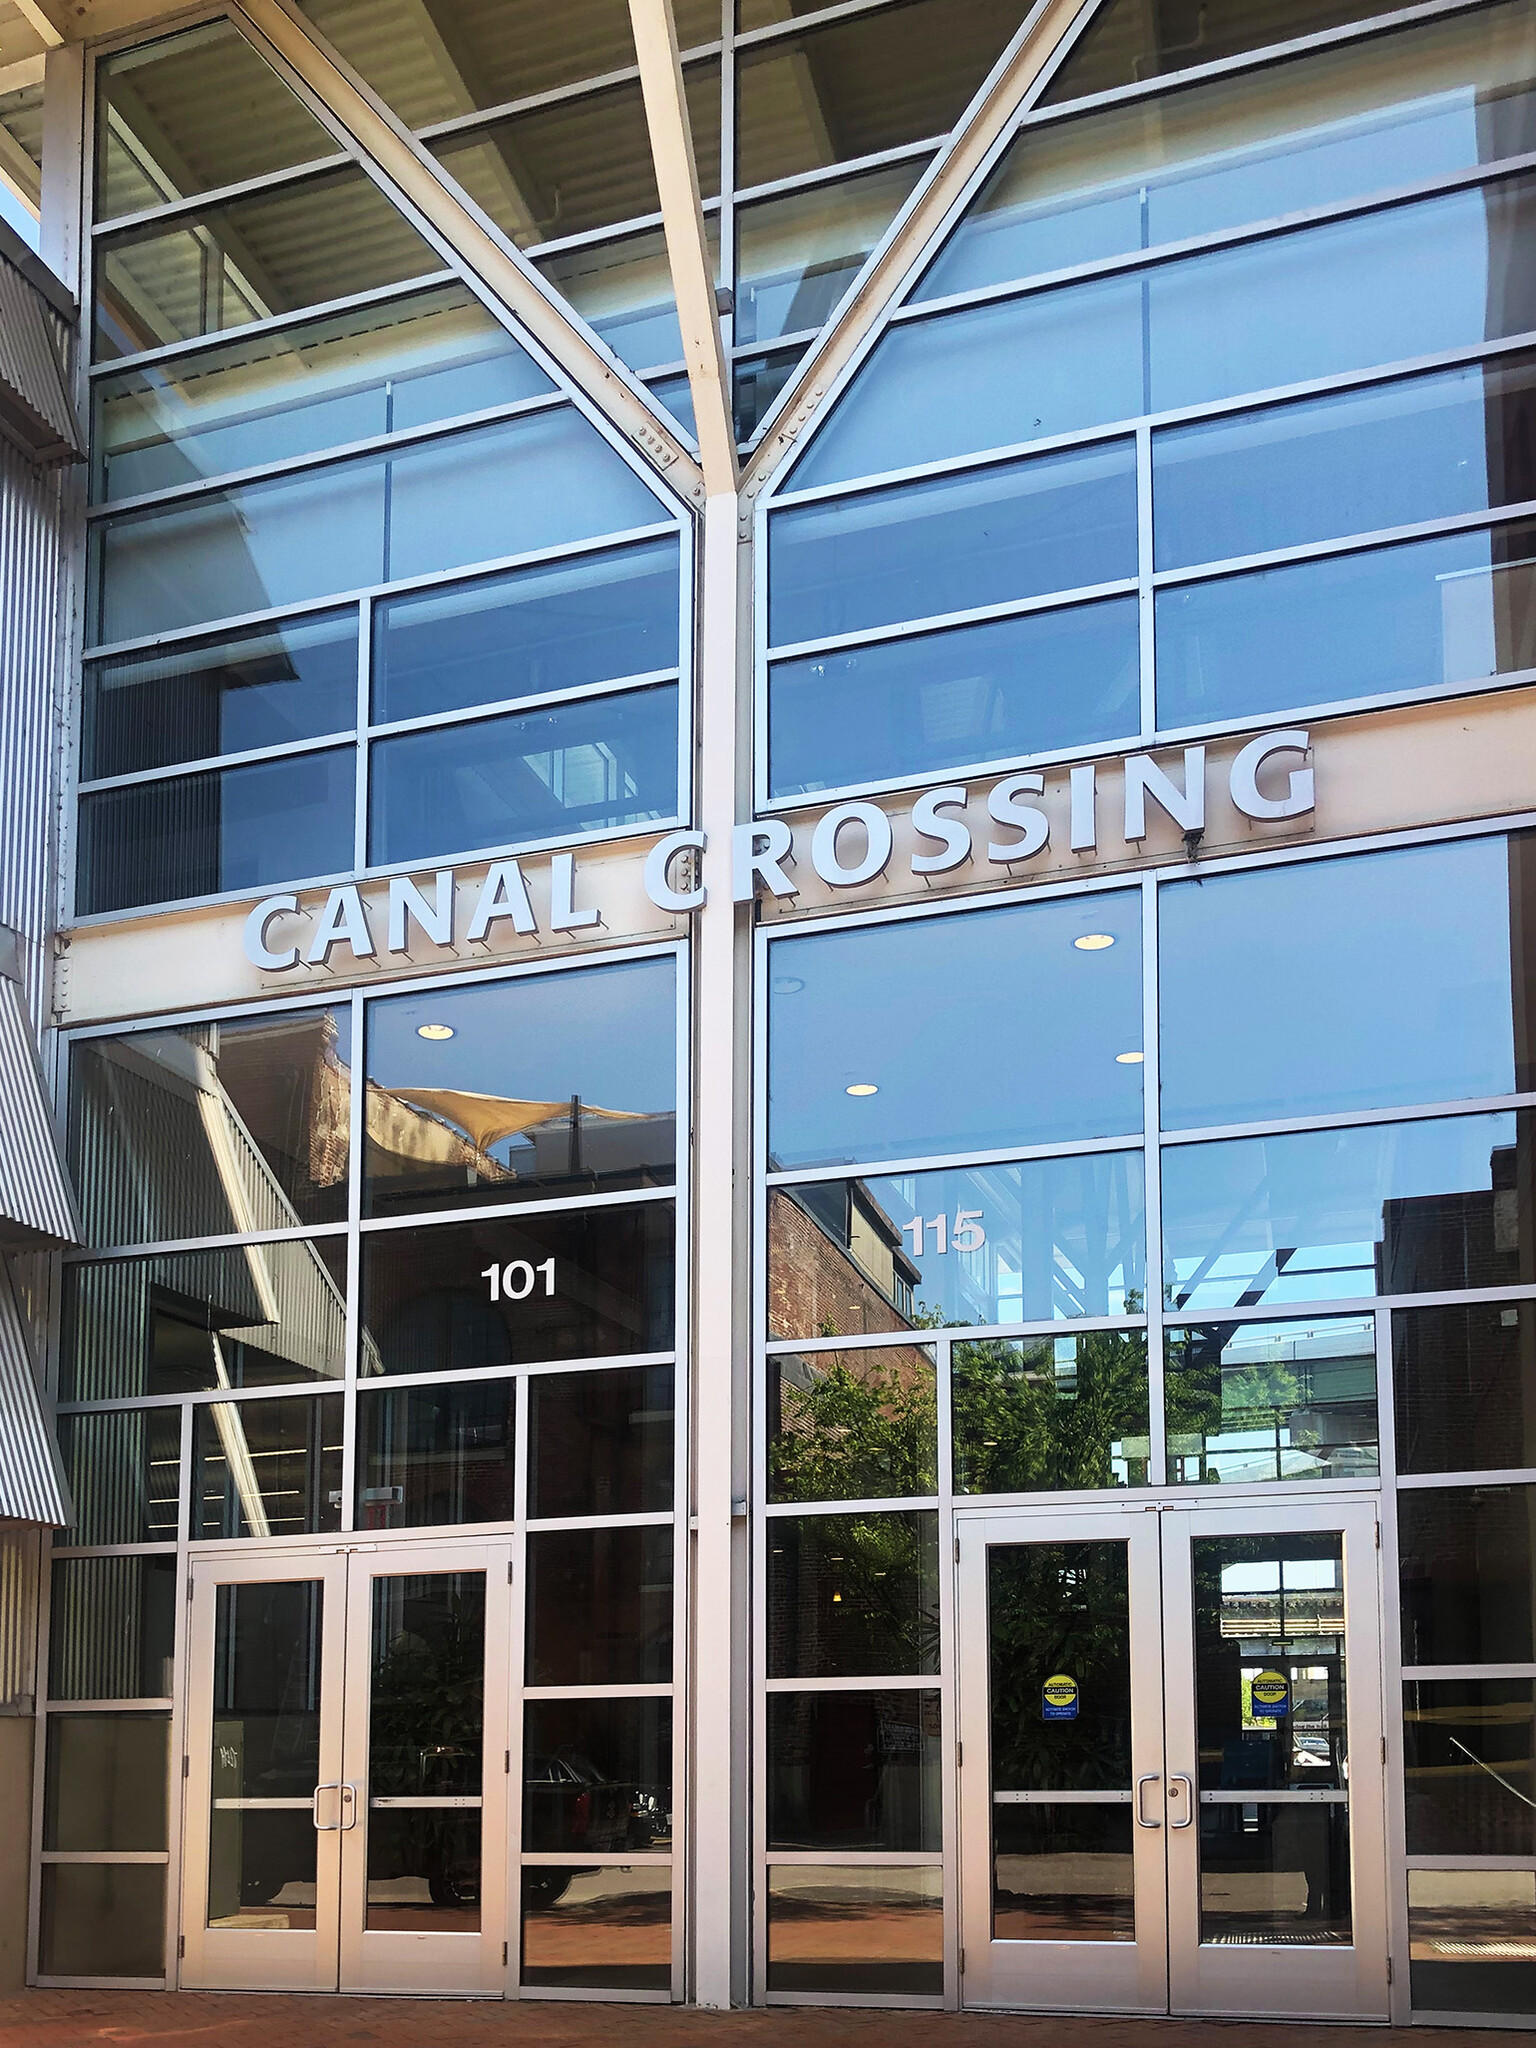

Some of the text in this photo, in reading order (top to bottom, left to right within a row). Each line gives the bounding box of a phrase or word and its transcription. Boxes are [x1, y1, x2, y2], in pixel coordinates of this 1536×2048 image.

[244, 729, 1317, 973] CANAL CROSSING
[902, 1210, 986, 1257] 115
[480, 1257, 556, 1302] 101
